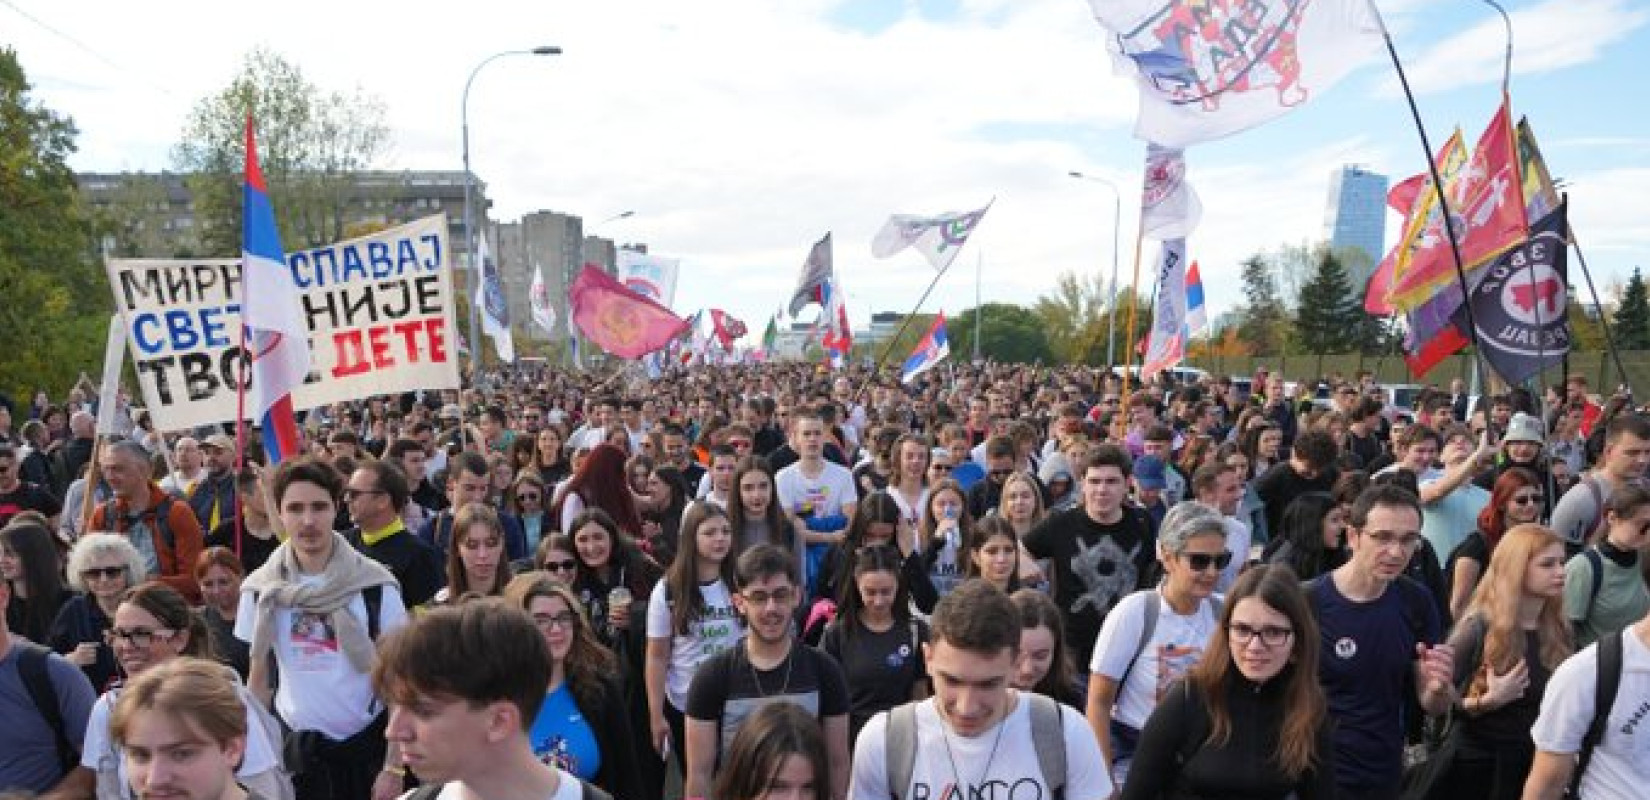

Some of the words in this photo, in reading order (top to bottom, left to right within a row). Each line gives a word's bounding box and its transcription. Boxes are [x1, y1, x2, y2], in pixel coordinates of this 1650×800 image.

[120, 264, 243, 311] МИРН
[290, 233, 441, 288] СПАВАЈ
[302, 275, 442, 332] НИЈЕ
[331, 318, 448, 379] ДЕТЕ
